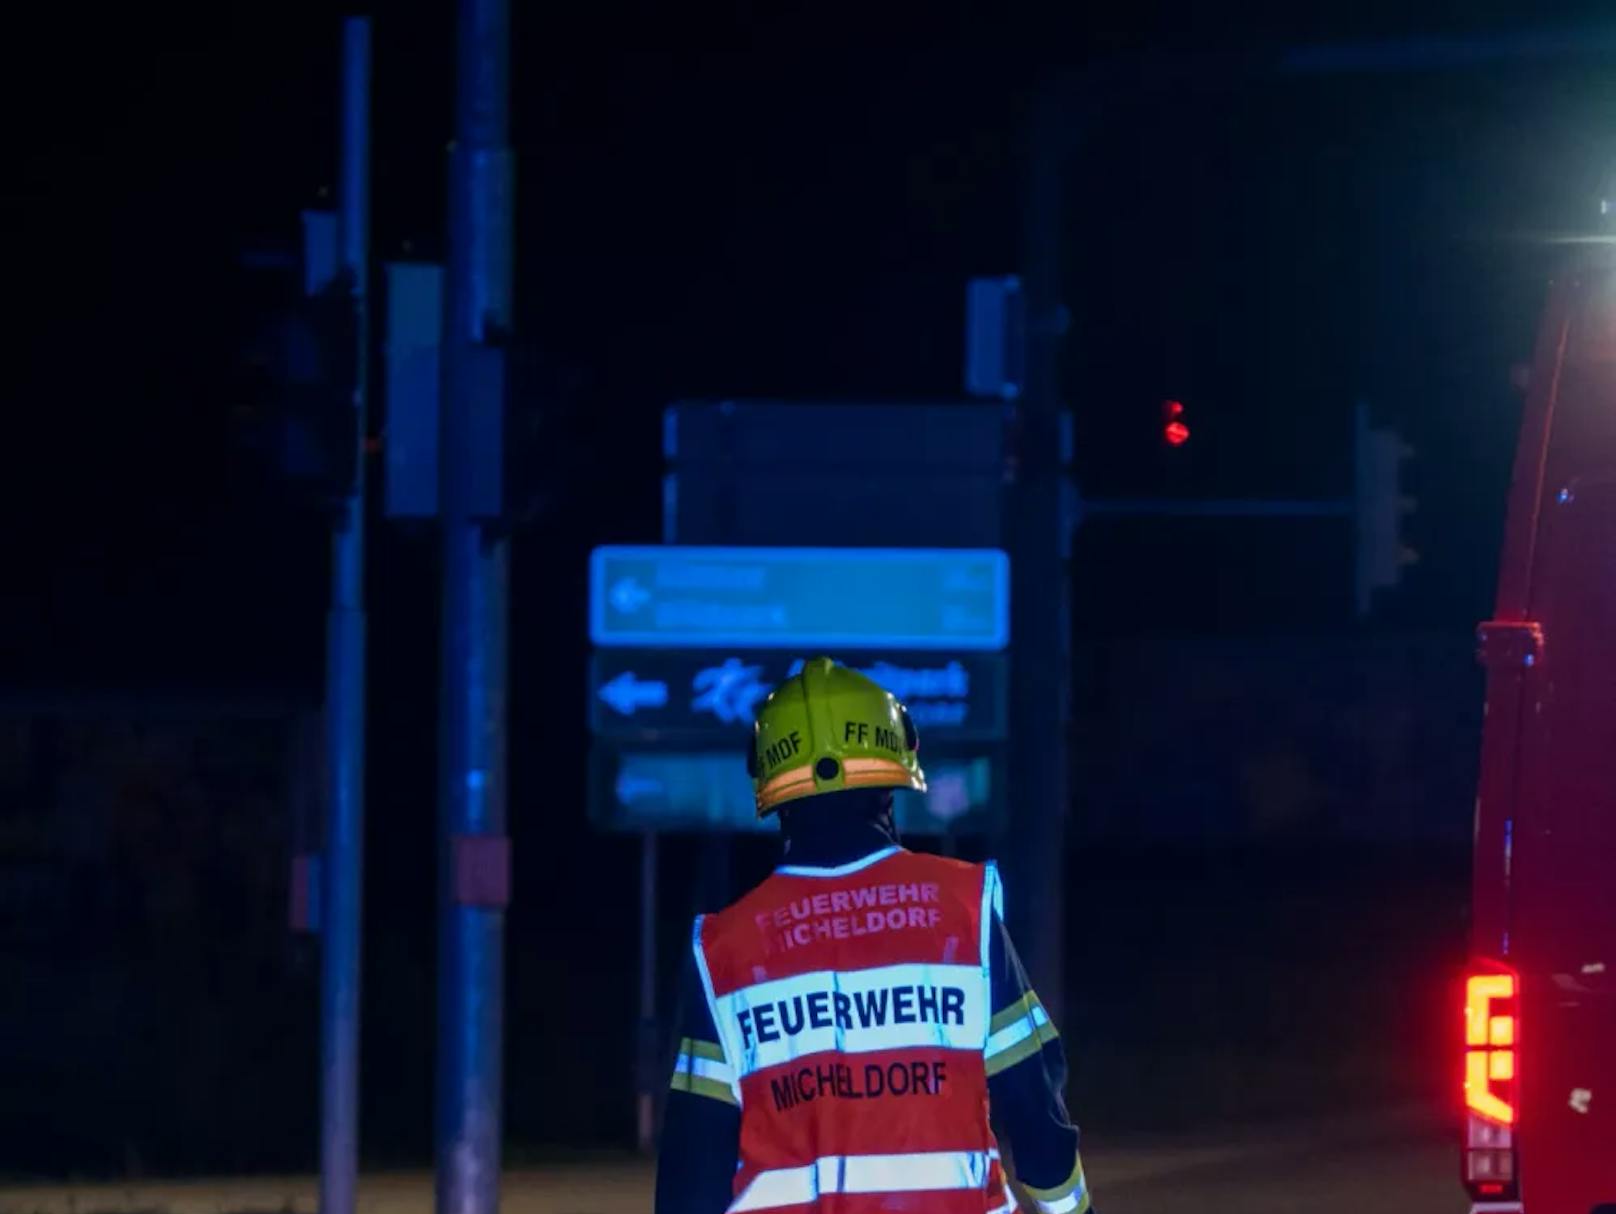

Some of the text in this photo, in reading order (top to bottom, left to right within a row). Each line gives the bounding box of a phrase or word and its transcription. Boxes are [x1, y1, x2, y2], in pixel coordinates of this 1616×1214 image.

[766, 731, 802, 769] MDF
[844, 720, 868, 744] FF
[754, 882, 940, 931] FEUERWEHR
[737, 985, 965, 1050] FEUERWEHR
[770, 1061, 946, 1112] MICHELDORF
